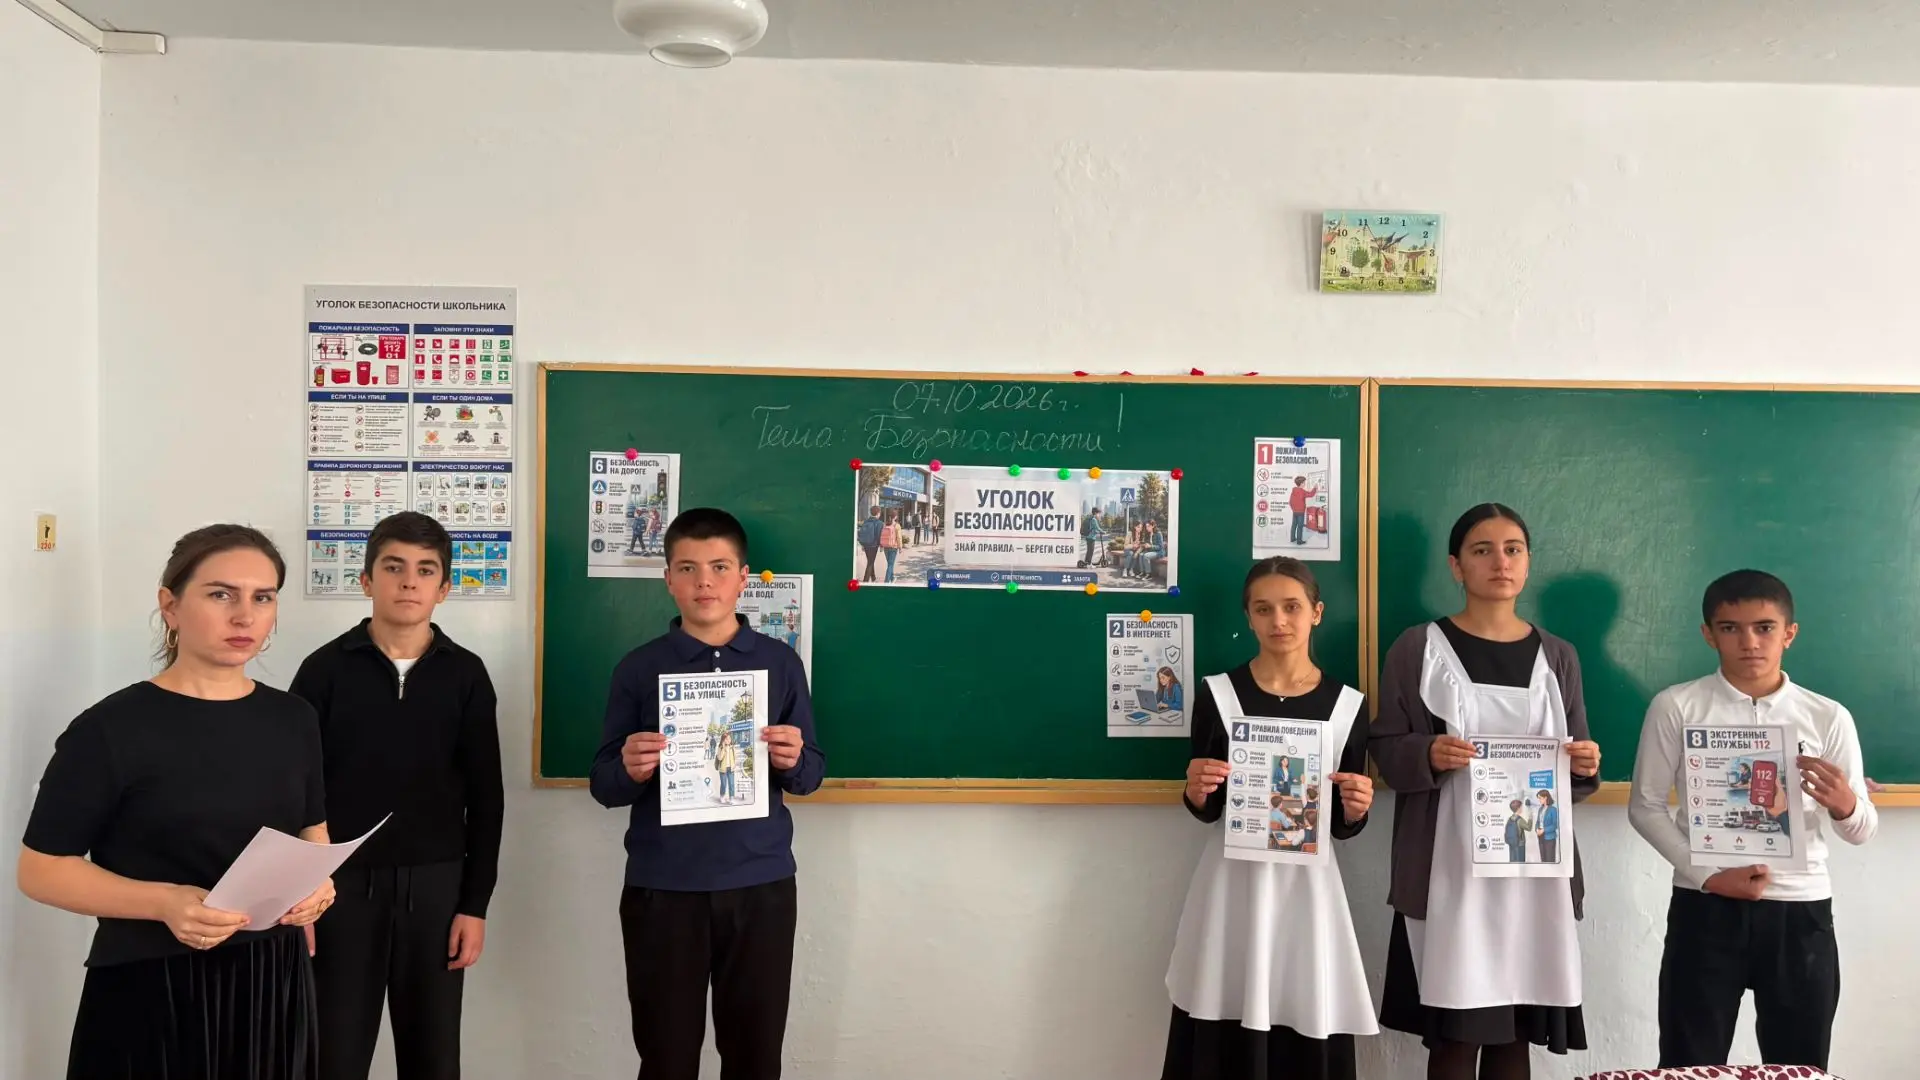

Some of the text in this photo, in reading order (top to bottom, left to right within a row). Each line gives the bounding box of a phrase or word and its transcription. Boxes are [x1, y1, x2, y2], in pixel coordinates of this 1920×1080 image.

[1358, 218, 1368, 226] 11
[1379, 217, 1390, 225] 12
[1401, 219, 1406, 227] 1
[1337, 229, 1348, 237] 10
[1422, 231, 1429, 239] 2
[1330, 247, 1336, 255] 9
[1429, 249, 1435, 257] 3
[1340, 266, 1347, 274] 8
[1359, 276, 1365, 284] 7
[1378, 279, 1384, 287] 6
[1398, 276, 1404, 284] 5
[316, 300, 506, 311] УГОЛОК БЕЗОПАСНОСТИ ШКОЛЬНИКА
[384, 344, 401, 352] 112
[1261, 446, 1269, 463] 1
[1275, 447, 1308, 455] ПОЖАРНАЯ
[610, 459, 660, 467] БЕЗОПАСНОСТЬ
[1275, 456, 1319, 465] БЕЗОПАСНОСТЬ
[595, 459, 604, 472] 6
[610, 467, 647, 475] НА ДОРОГЕ
[892, 490, 913, 498] ШКОЛА
[976, 489, 1055, 510] УГОЛОК
[954, 511, 1075, 532] БЕЗОПАСНОСТИ
[954, 541, 976, 552] ЗНАЙ
[978, 543, 1014, 553] ПРАВИЛА
[1025, 544, 1053, 554] БЕРЕГИ
[1055, 545, 1075, 554] СЕБЯ
[743, 590, 775, 599] НА ВОДЕ
[1112, 621, 1121, 636] 2
[1126, 620, 1178, 629] БЕЗОПАСНОСТЬ
[1126, 630, 1171, 638] В ИНТЕРНЕТЕ
[683, 679, 747, 690] БЕЗОПАСНОСТЬ
[666, 684, 677, 699] 5
[684, 690, 726, 700] НА УЛИЦЕ
[1234, 724, 1246, 740] 4
[1251, 724, 1317, 736] ПРАВИЛА ПОВЕДЕНИЯ
[1251, 734, 1284, 744] В ШКОЛЕ
[1691, 731, 1703, 747] 8
[1710, 731, 1768, 740] ЭКСТРЕННЫЕ
[1710, 740, 1771, 750] СЛУЖБЫ 112
[1476, 743, 1485, 757] 3
[1490, 750, 1541, 759] БЕЗОПАСНОСТЬ
[1755, 769, 1773, 781] 112
